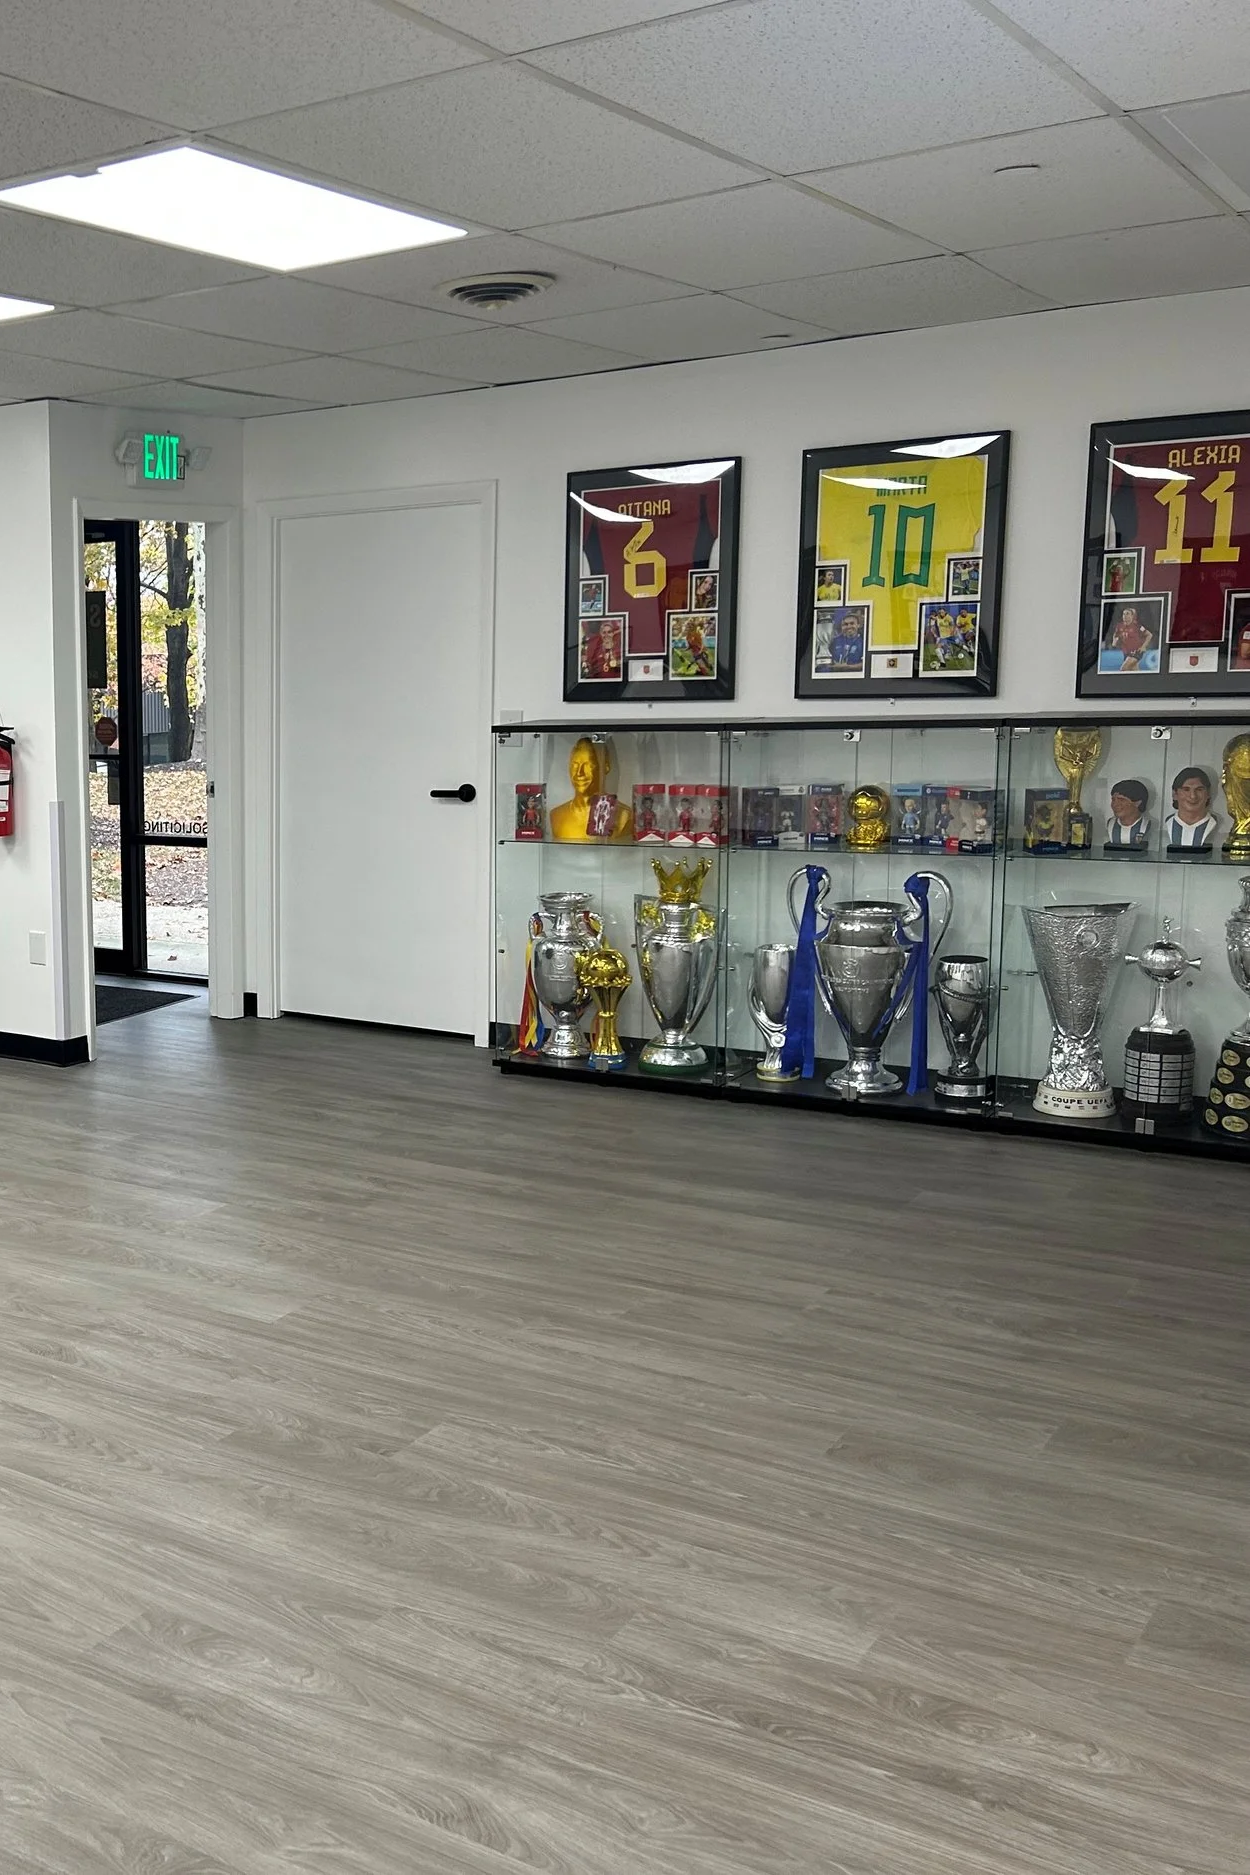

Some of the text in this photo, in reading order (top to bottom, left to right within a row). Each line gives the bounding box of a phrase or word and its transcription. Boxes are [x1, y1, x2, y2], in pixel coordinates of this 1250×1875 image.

[143, 433, 180, 481] EXIT
[1168, 444, 1241, 468] ALEXIA
[862, 503, 936, 588] 10
[1153, 470, 1241, 565] 11
[623, 520, 667, 599] 6
[1051, 1096, 1083, 1105] COUPE
